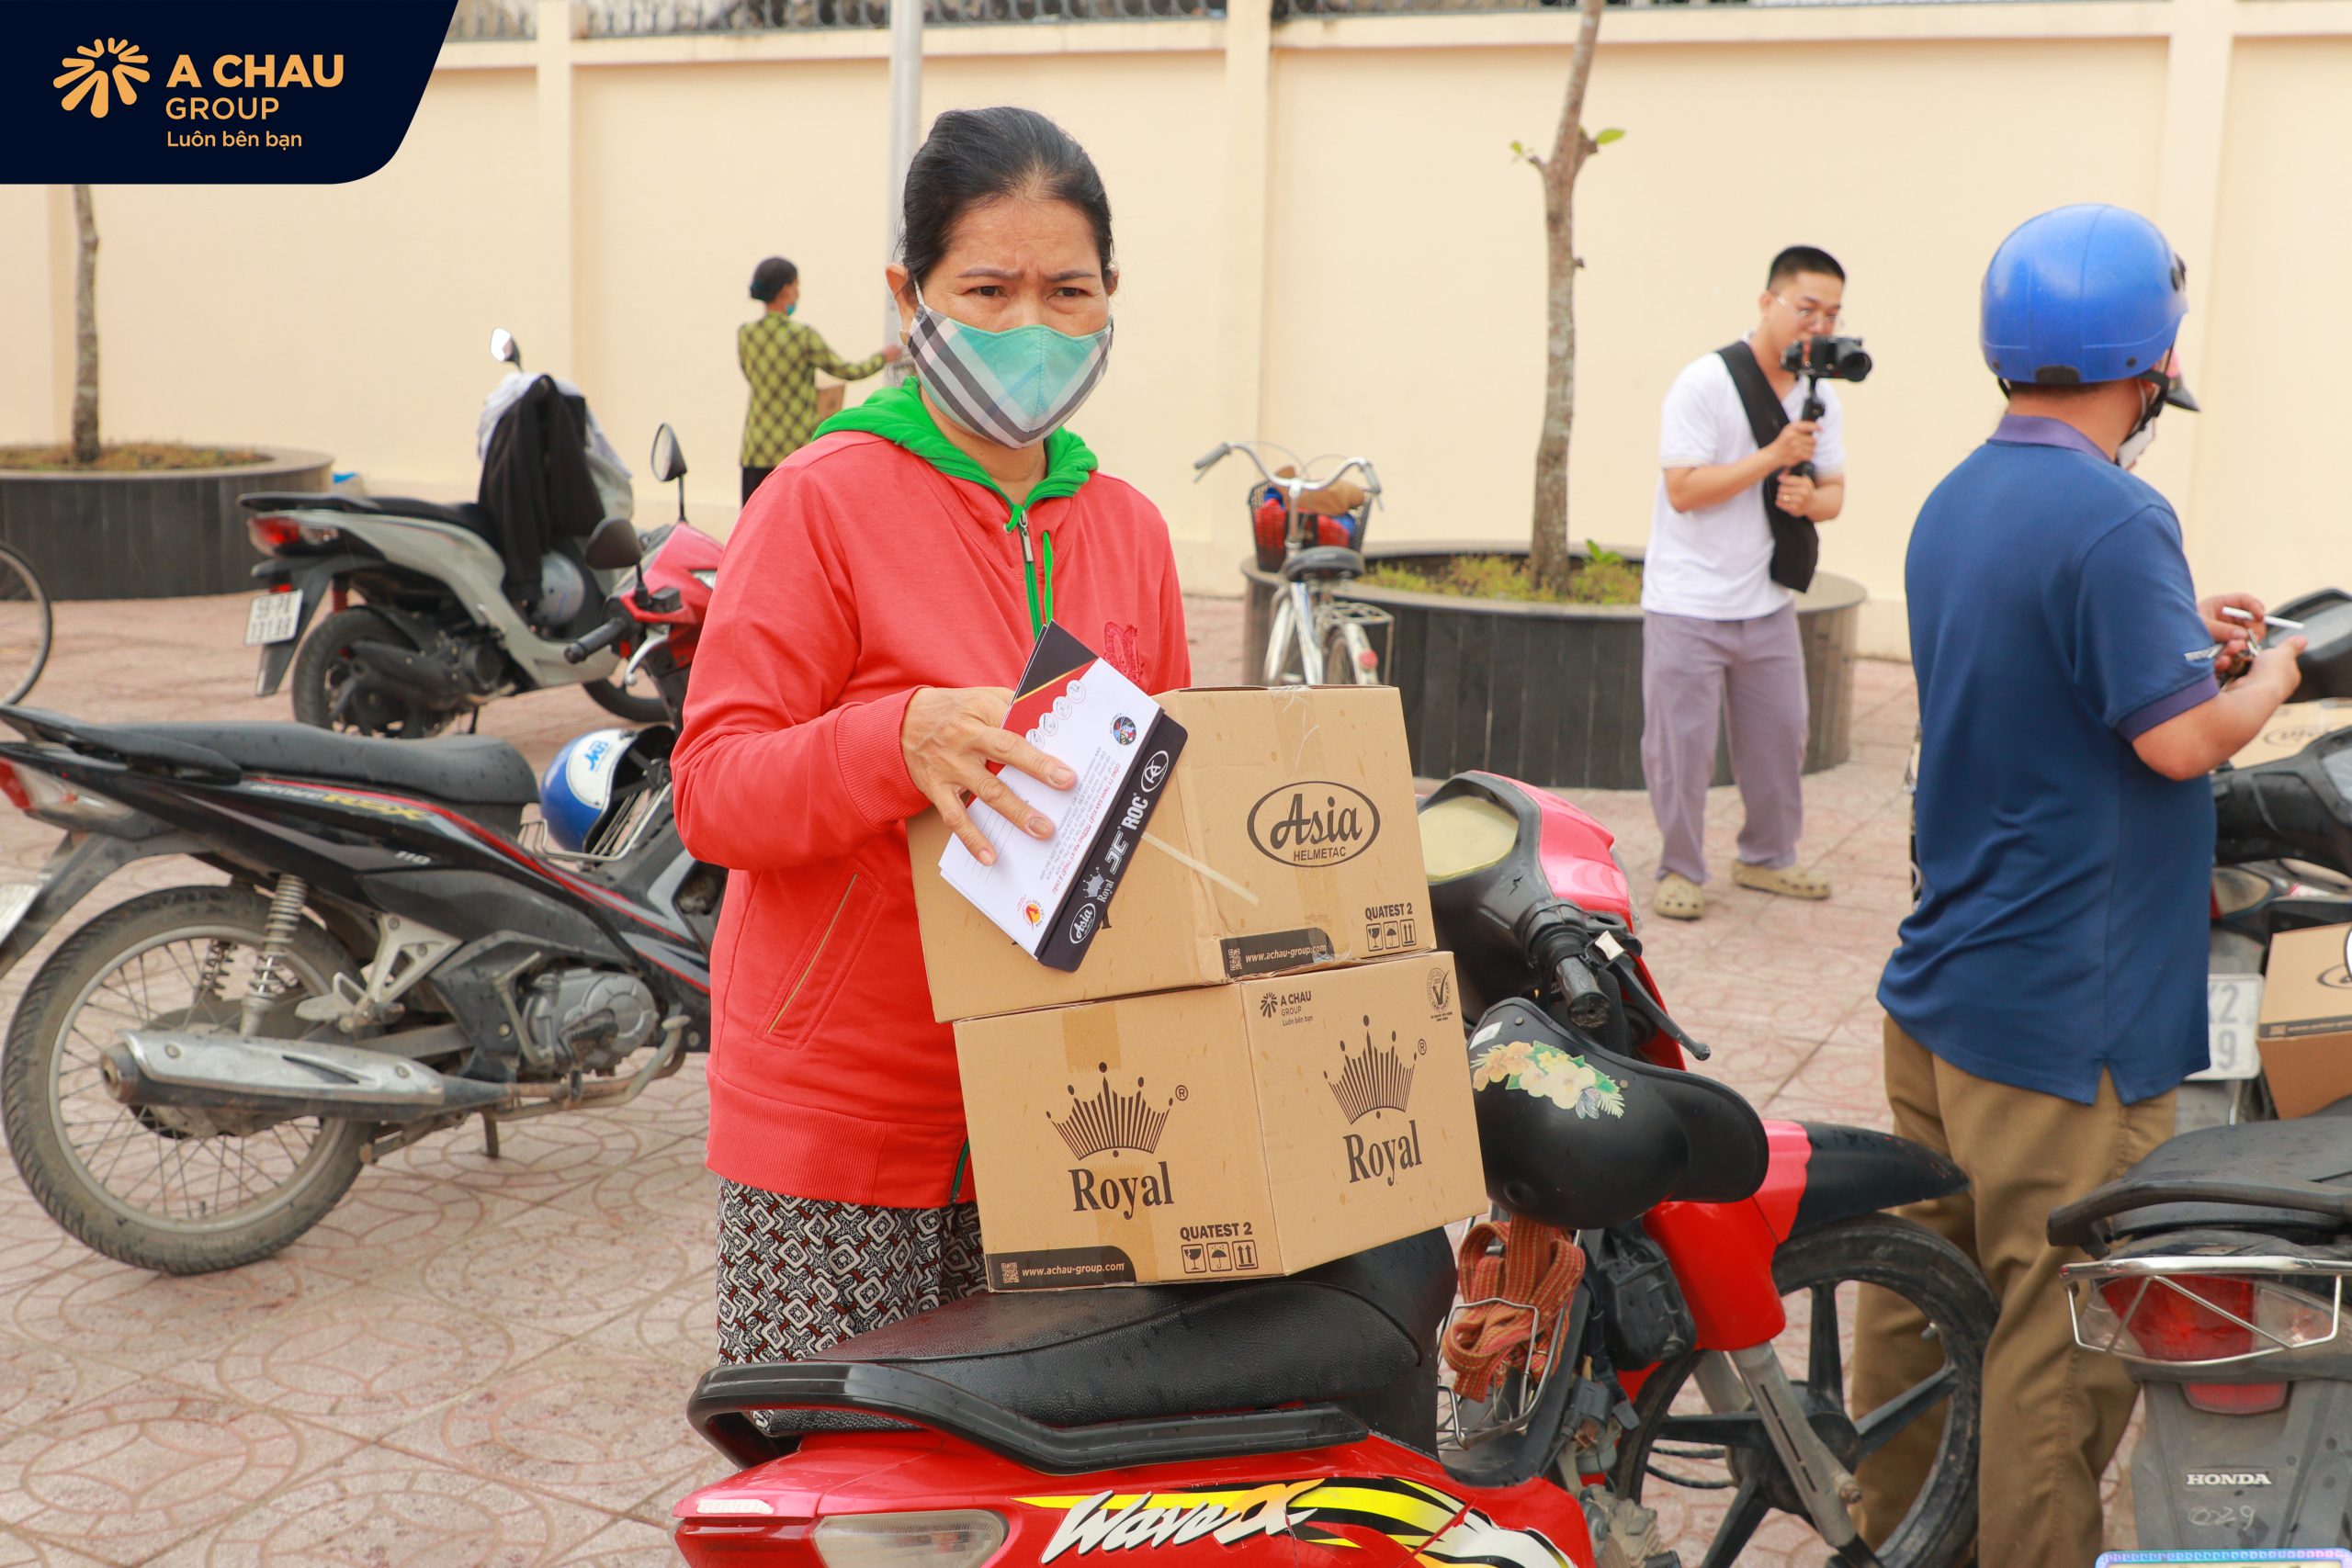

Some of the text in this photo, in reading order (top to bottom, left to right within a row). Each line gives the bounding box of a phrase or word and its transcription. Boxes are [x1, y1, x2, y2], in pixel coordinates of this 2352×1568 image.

[1122, 795, 1148, 830] ROC
[1270, 793, 1363, 850] Asia
[1293, 846, 1347, 862] HELMETAC
[1097, 879, 1114, 903] Royal
[1364, 902, 1413, 920] QUATEST 2
[1075, 908, 1093, 939] Asia
[1245, 943, 1327, 963] www.achau-group.com
[1281, 990, 1312, 1007] A CHAU
[1282, 1006, 1302, 1017] GROUP
[1342, 1119, 1423, 1187] Royal
[1068, 1161, 1174, 1220] Royal
[1180, 1222, 1252, 1240] QUATEST 2
[1022, 1262, 1125, 1278] www.achau-group.com
[2186, 1473, 2272, 1485] HONDA
[1040, 1489, 1240, 1564] Wave
